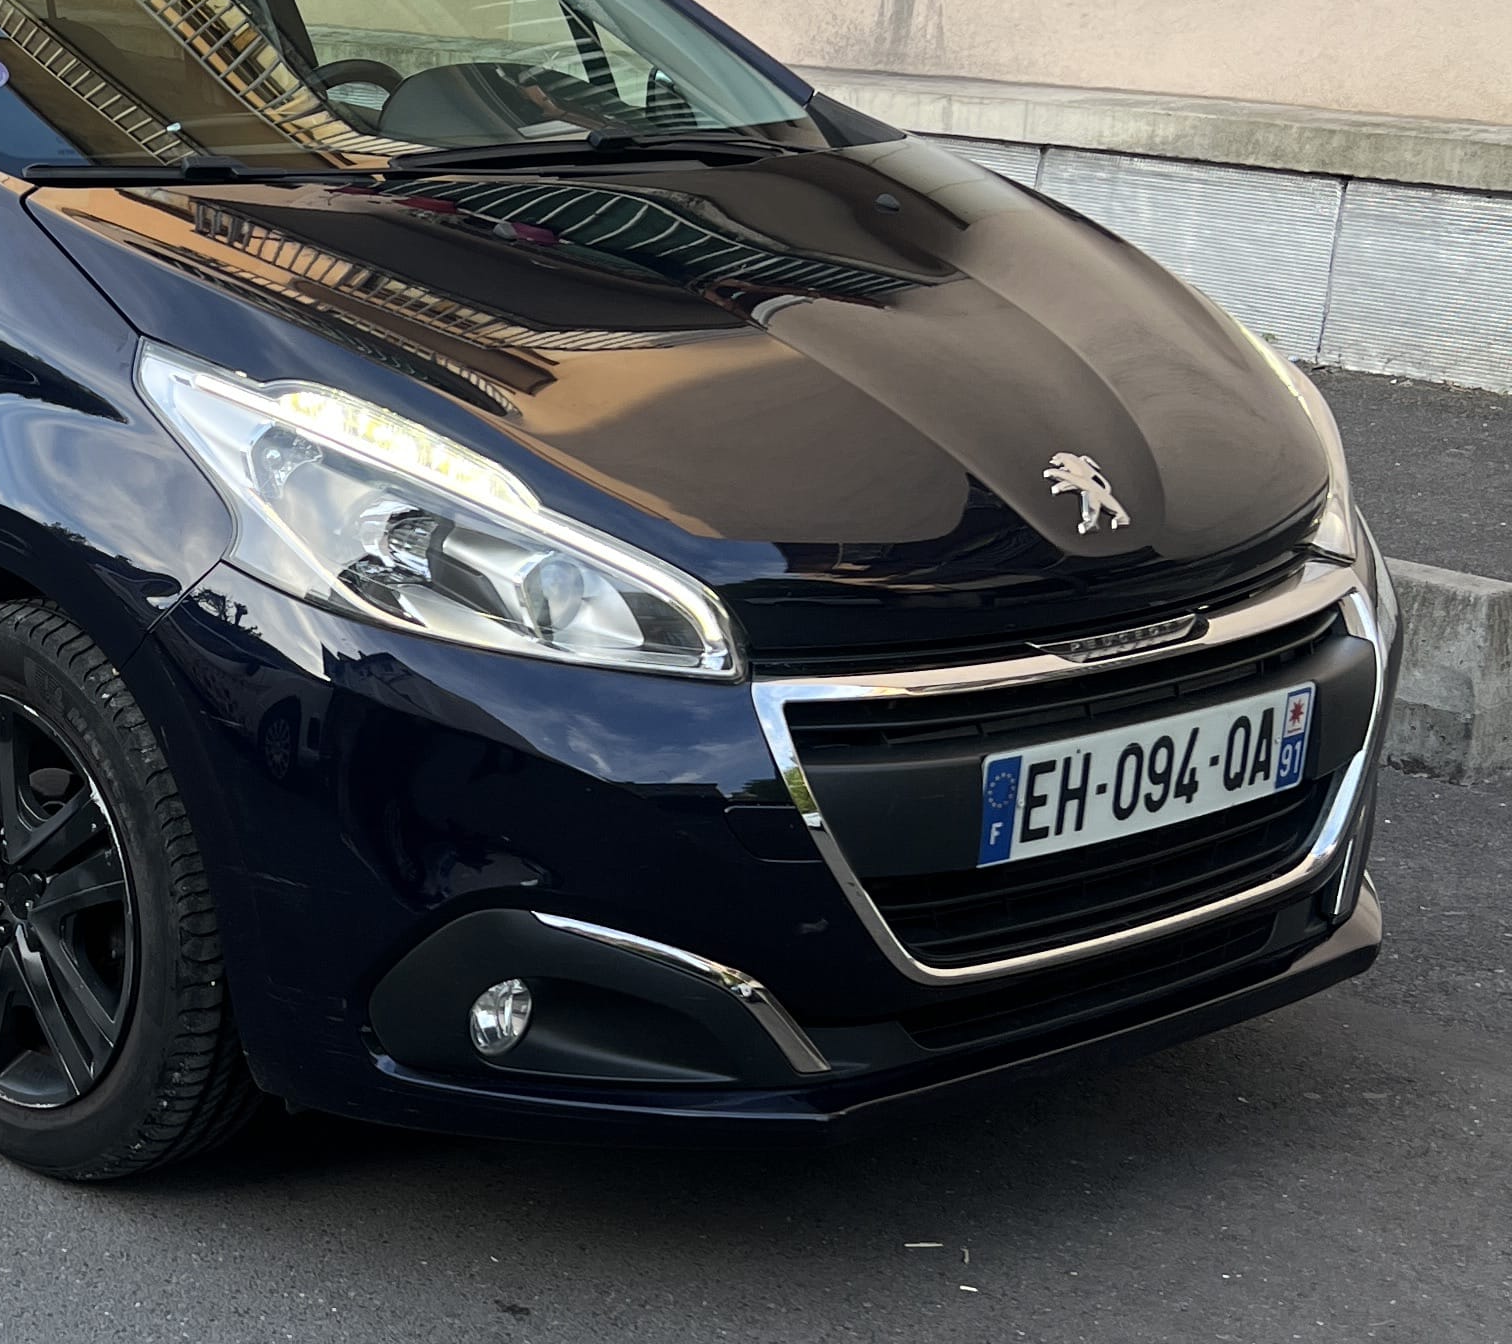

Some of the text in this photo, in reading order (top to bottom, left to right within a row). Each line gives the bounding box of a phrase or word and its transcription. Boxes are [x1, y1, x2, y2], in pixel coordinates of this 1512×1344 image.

[1020, 707, 1275, 843] EH-094-QA
[1279, 739, 1303, 778] 91
[989, 822, 1003, 845] F
